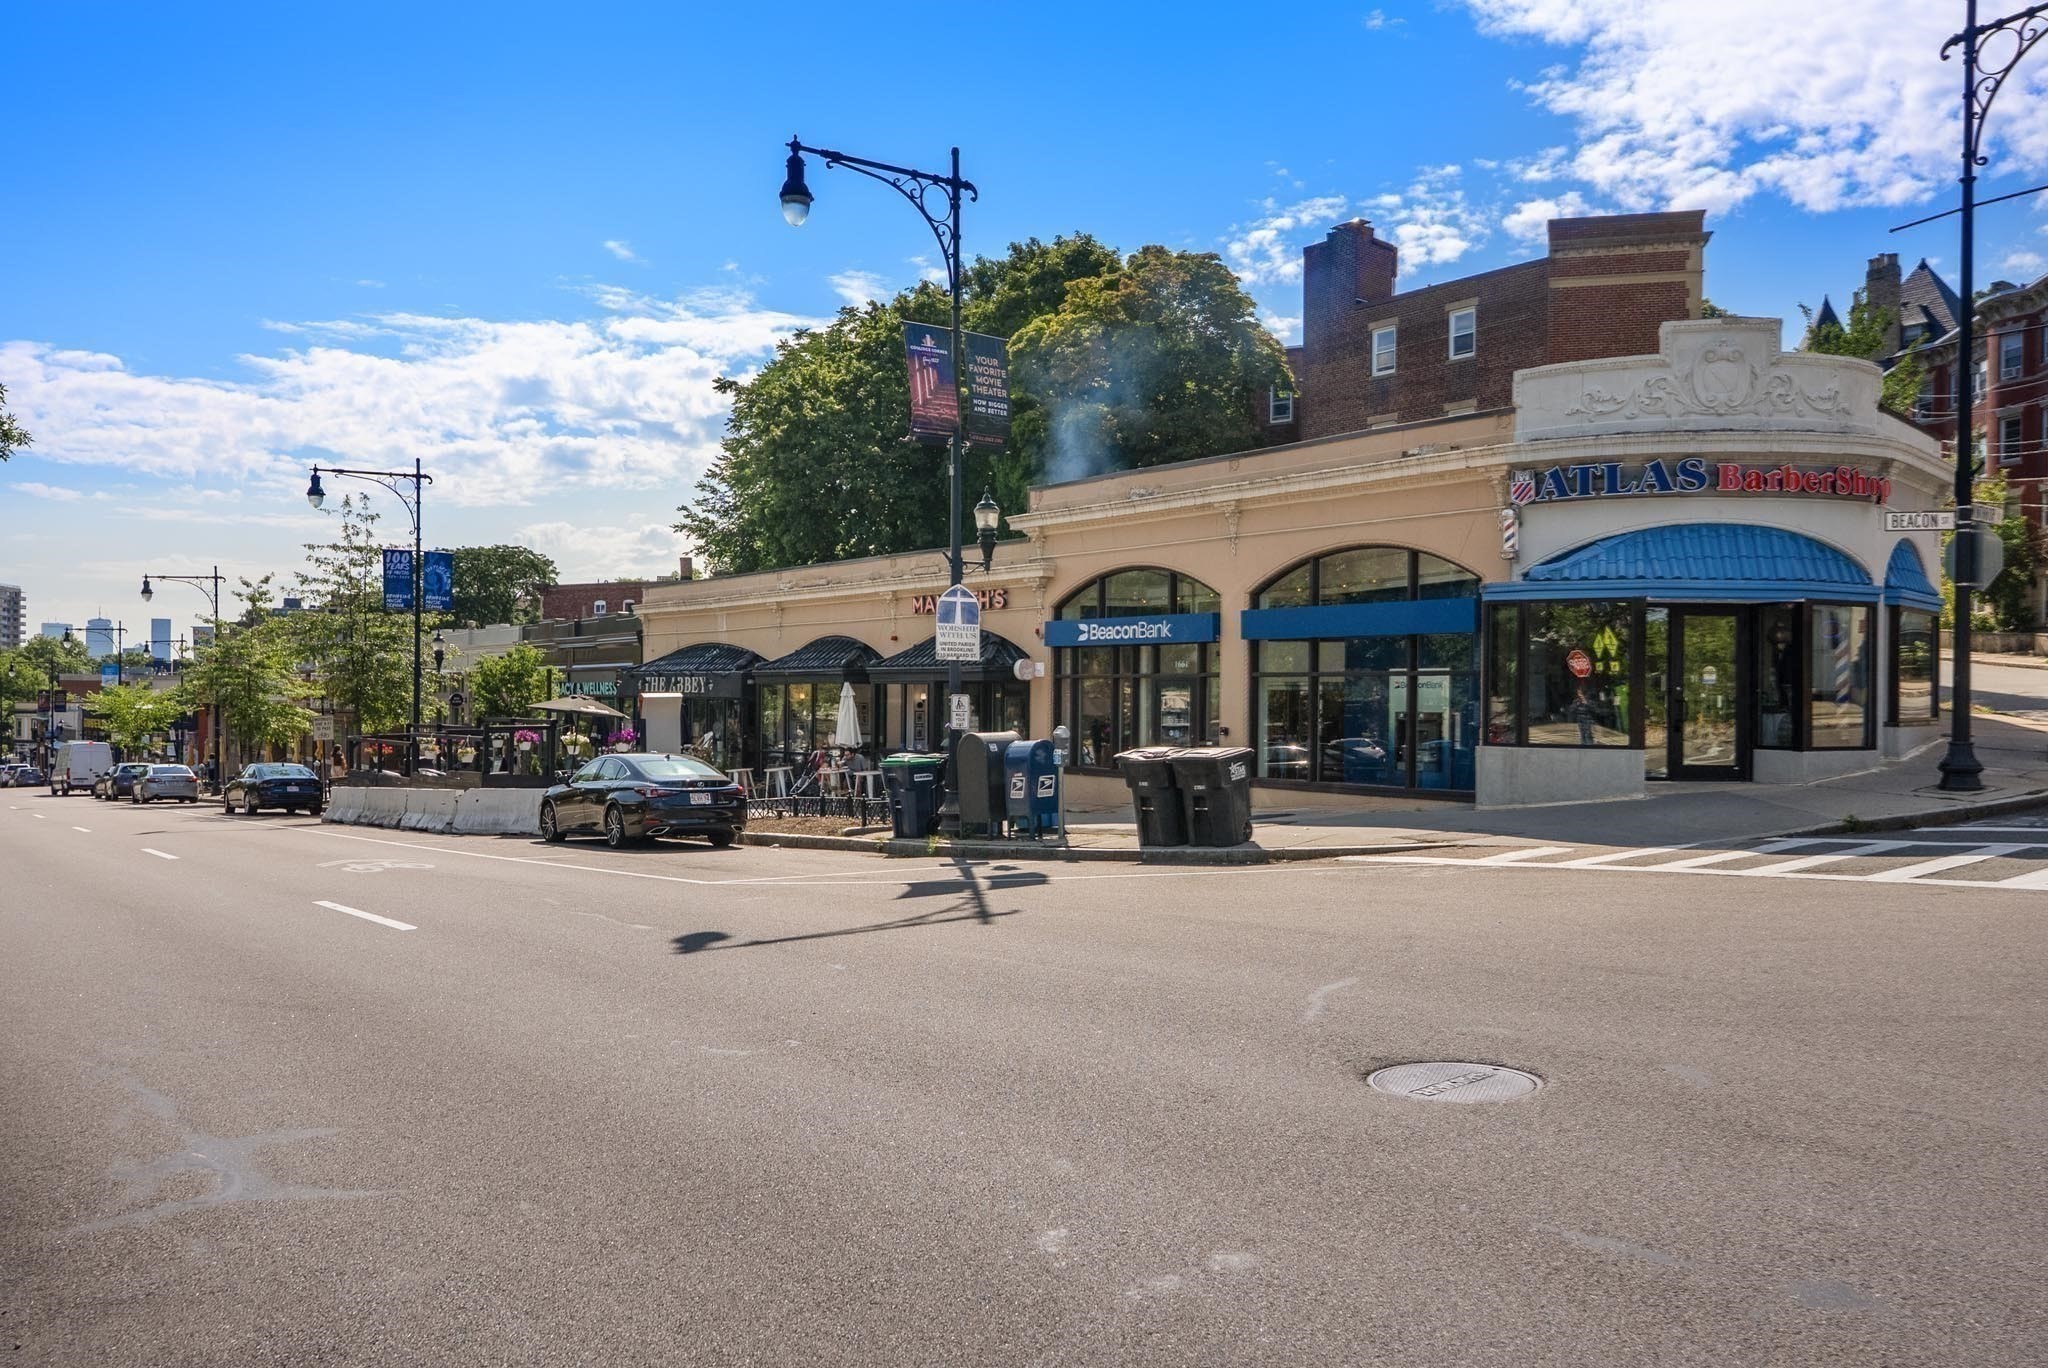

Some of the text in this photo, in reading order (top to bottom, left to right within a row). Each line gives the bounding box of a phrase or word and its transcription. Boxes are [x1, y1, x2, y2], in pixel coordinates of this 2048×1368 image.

[976, 356, 998, 367] YOUR
[968, 364, 1006, 378] FAVORITE
[976, 376, 1002, 387] MOVIE
[972, 384, 1008, 398] THEATER
[988, 401, 1008, 410] BIGGER
[988, 408, 1008, 416] BETTER
[1536, 458, 1708, 501] ATLAS
[1891, 513, 1938, 528] BEACON
[386, 552, 410, 563] 100
[1089, 620, 1172, 640] BeaconBank
[576, 684, 583, 694] &
[583, 682, 617, 696] WELLNESS
[644, 676, 707, 694] THE ABBEY
